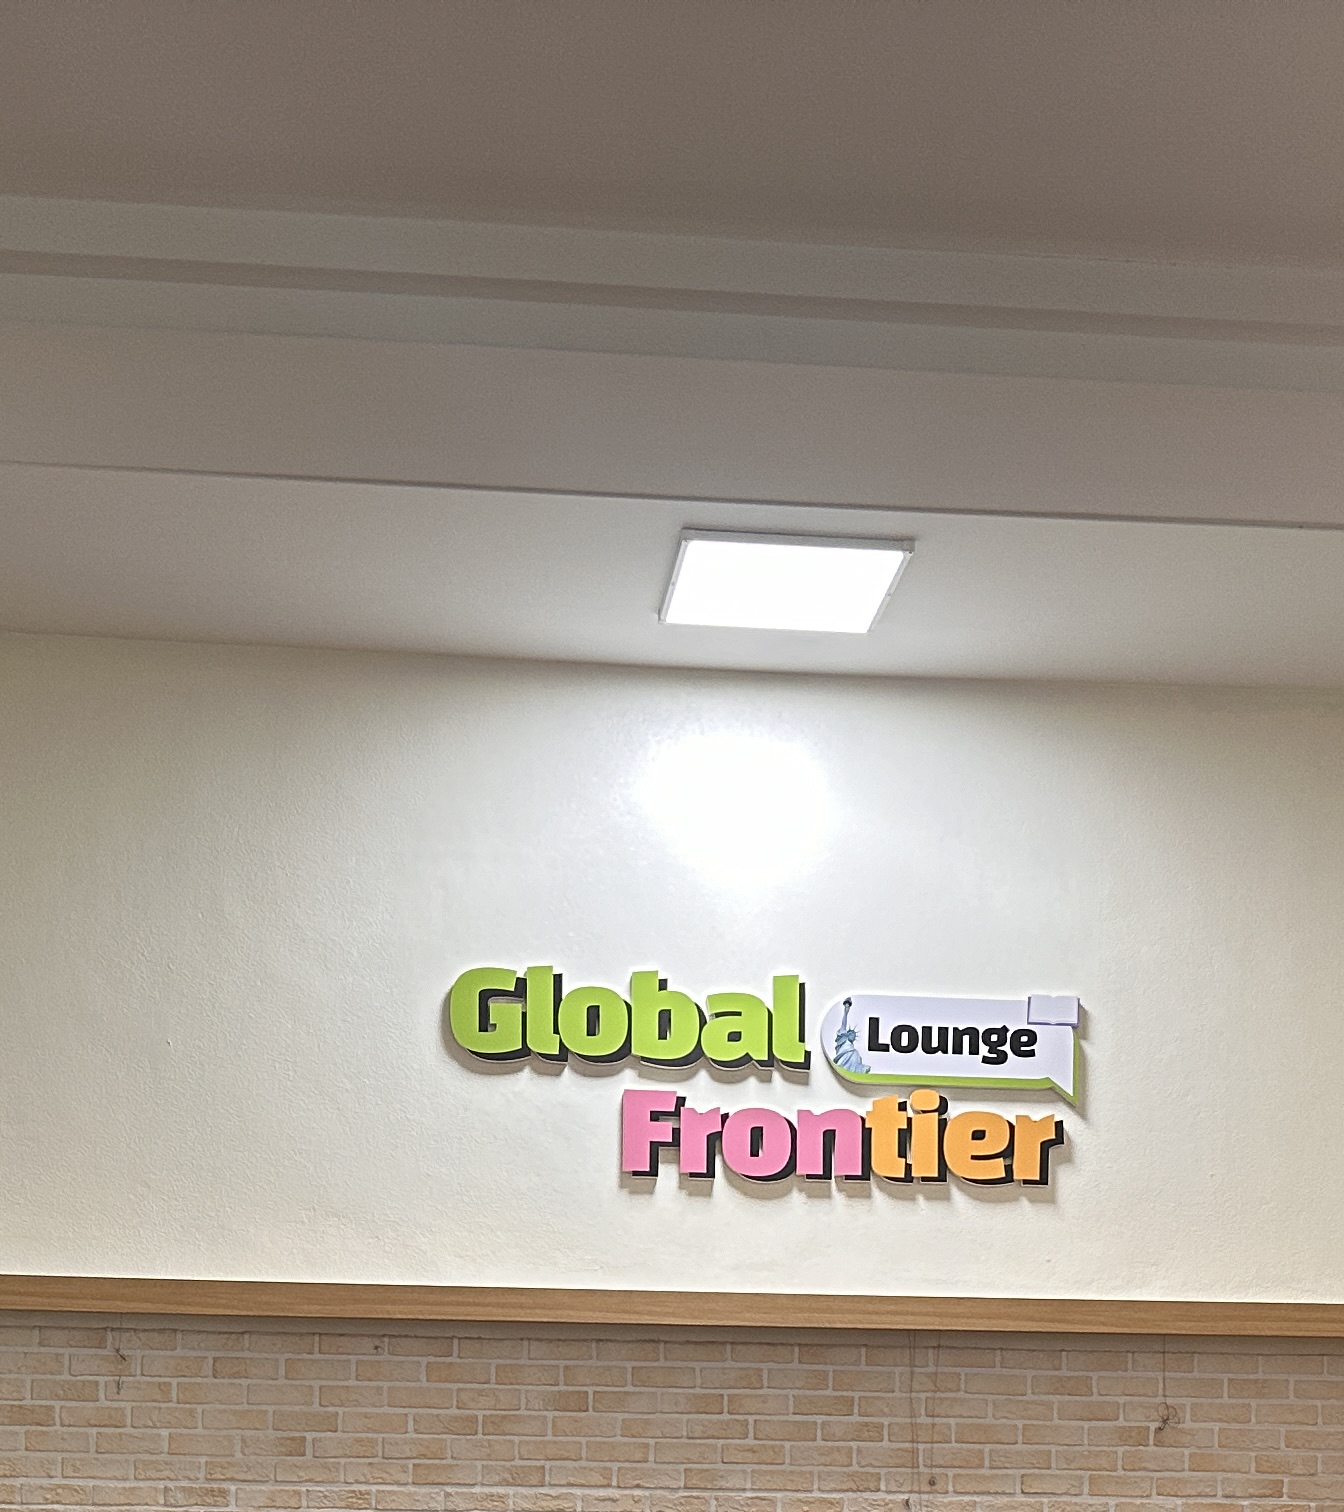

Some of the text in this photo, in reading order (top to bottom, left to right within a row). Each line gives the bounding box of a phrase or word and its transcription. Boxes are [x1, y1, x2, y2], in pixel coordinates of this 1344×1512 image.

[449, 966, 808, 1065] Global
[867, 1015, 1038, 1064] Lounge
[622, 1089, 1060, 1182] Frontier
